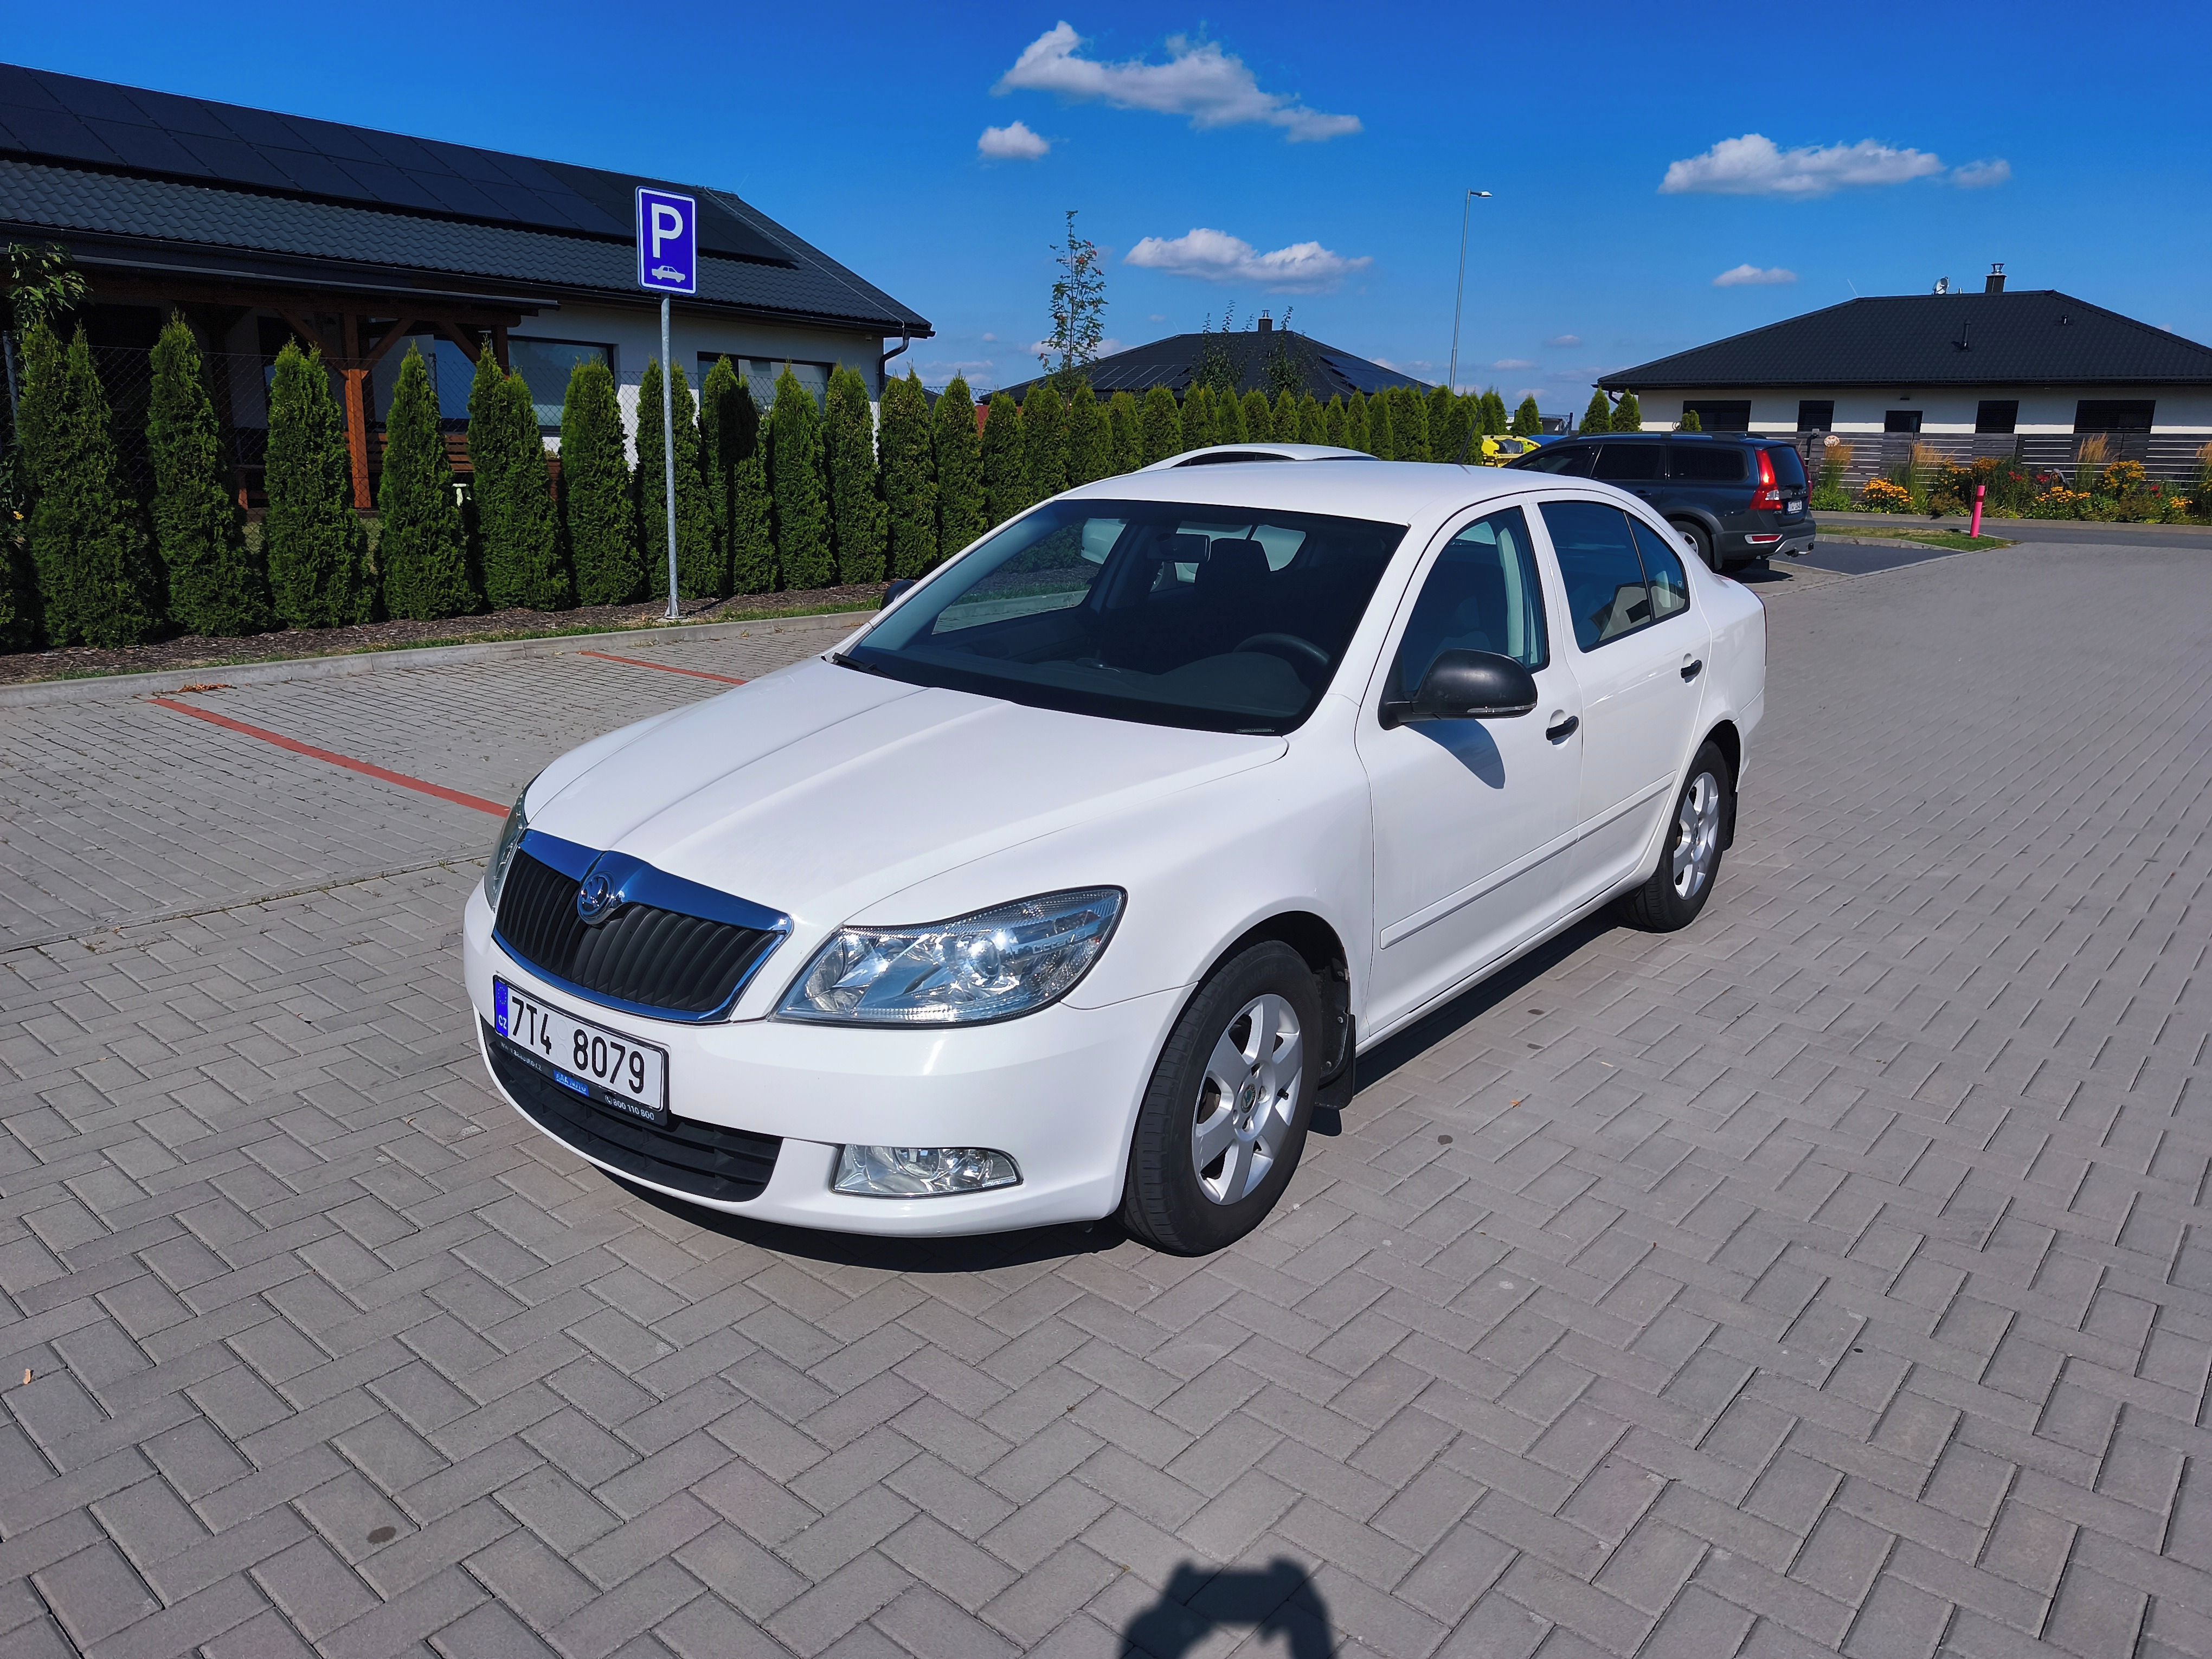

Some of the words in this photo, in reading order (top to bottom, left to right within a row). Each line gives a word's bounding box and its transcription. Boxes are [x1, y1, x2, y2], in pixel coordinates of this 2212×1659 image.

[652, 203, 683, 258] P
[498, 1014, 507, 1030] CZ
[511, 996, 552, 1056] 7T4
[573, 1028, 645, 1094] 8079
[613, 1098, 626, 1110] 800
[627, 1104, 640, 1115] 110
[640, 1109, 654, 1120] 800
